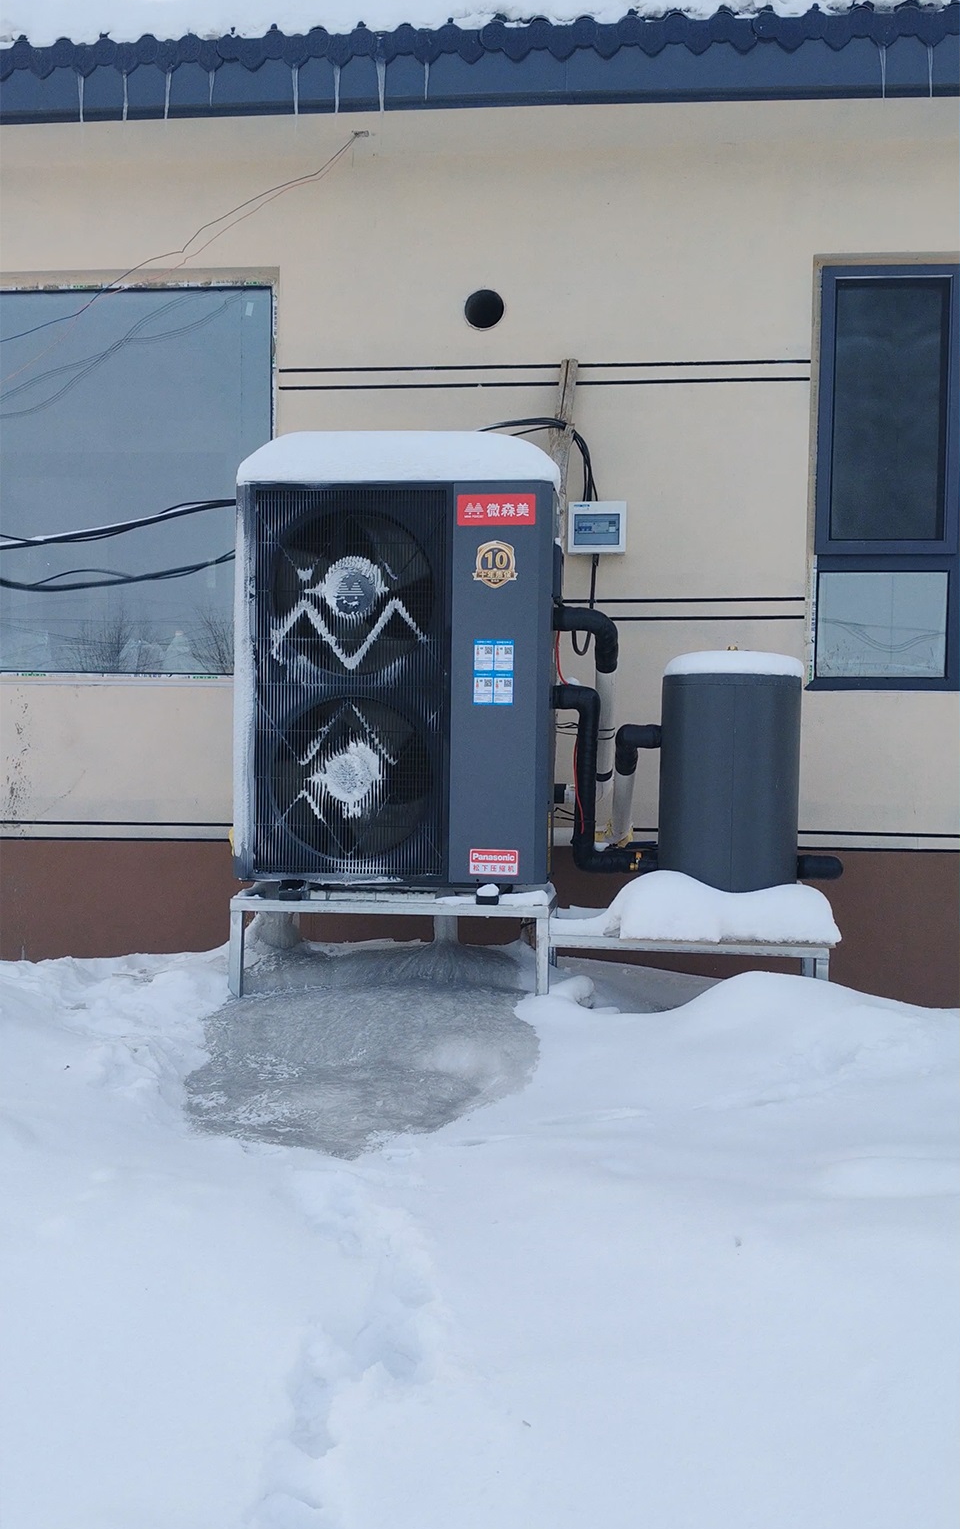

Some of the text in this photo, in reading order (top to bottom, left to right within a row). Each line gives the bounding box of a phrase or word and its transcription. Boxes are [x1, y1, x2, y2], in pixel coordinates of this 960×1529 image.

[486, 502, 530, 518] 微森美
[484, 551, 508, 569] 10
[472, 852, 516, 862] Panasonic
[473, 864, 515, 873] 松下压缩机
